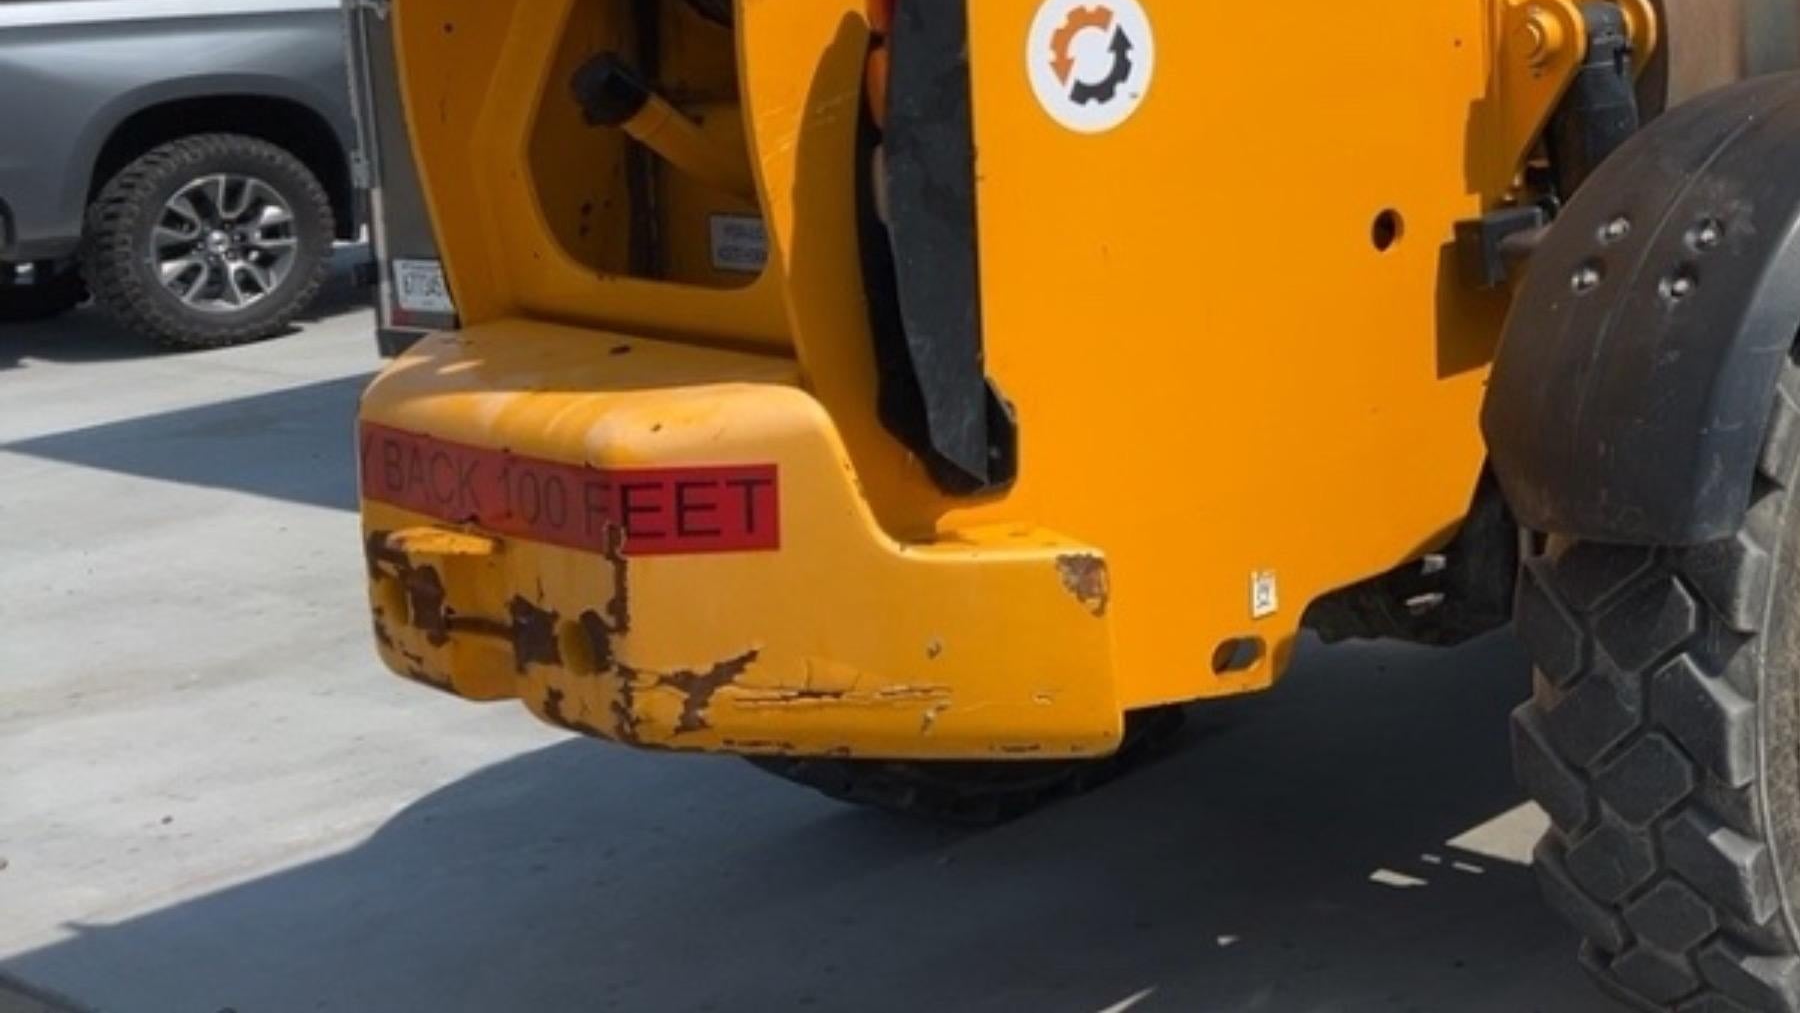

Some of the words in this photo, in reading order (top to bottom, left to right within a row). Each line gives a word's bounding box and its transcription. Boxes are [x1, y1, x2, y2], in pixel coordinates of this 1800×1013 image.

[384, 438, 482, 512] BACK
[495, 462, 569, 529] 100
[583, 476, 773, 541] FEET
